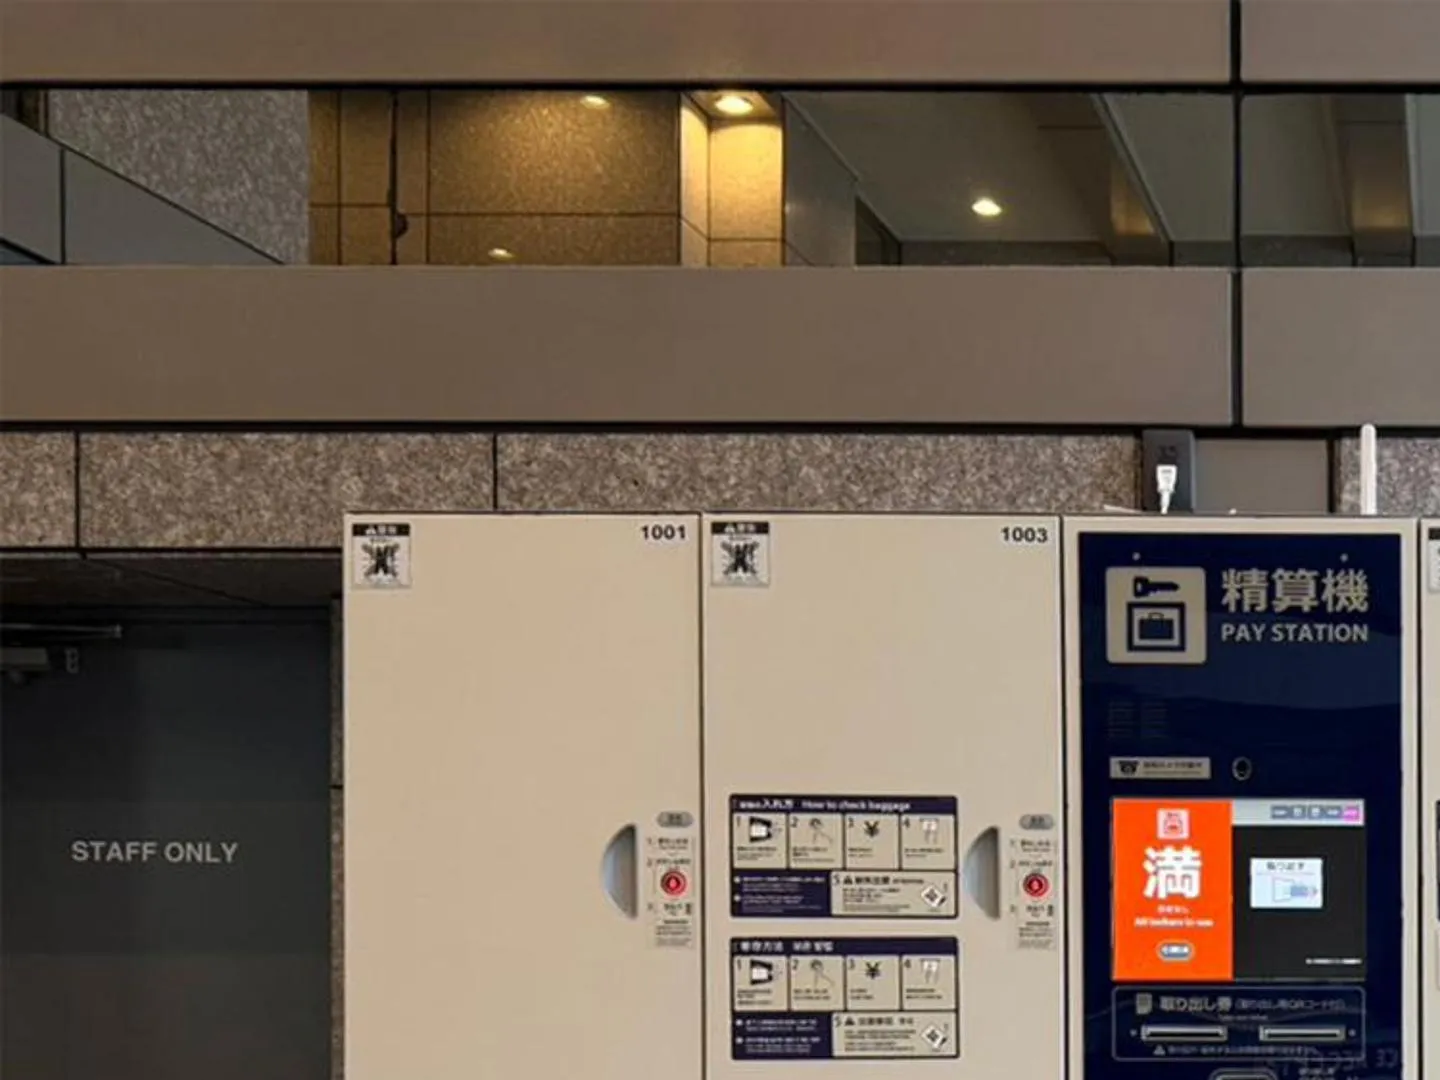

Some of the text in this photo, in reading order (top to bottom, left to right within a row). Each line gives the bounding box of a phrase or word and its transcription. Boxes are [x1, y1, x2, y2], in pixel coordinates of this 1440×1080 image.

[641, 524, 686, 541] 1001
[1002, 526, 1048, 543] 1003
[1221, 567, 1369, 613] 精算機
[1221, 623, 1369, 642] PAY STATION
[71, 840, 238, 863] STAFF ONLY
[1143, 846, 1203, 899] 満
